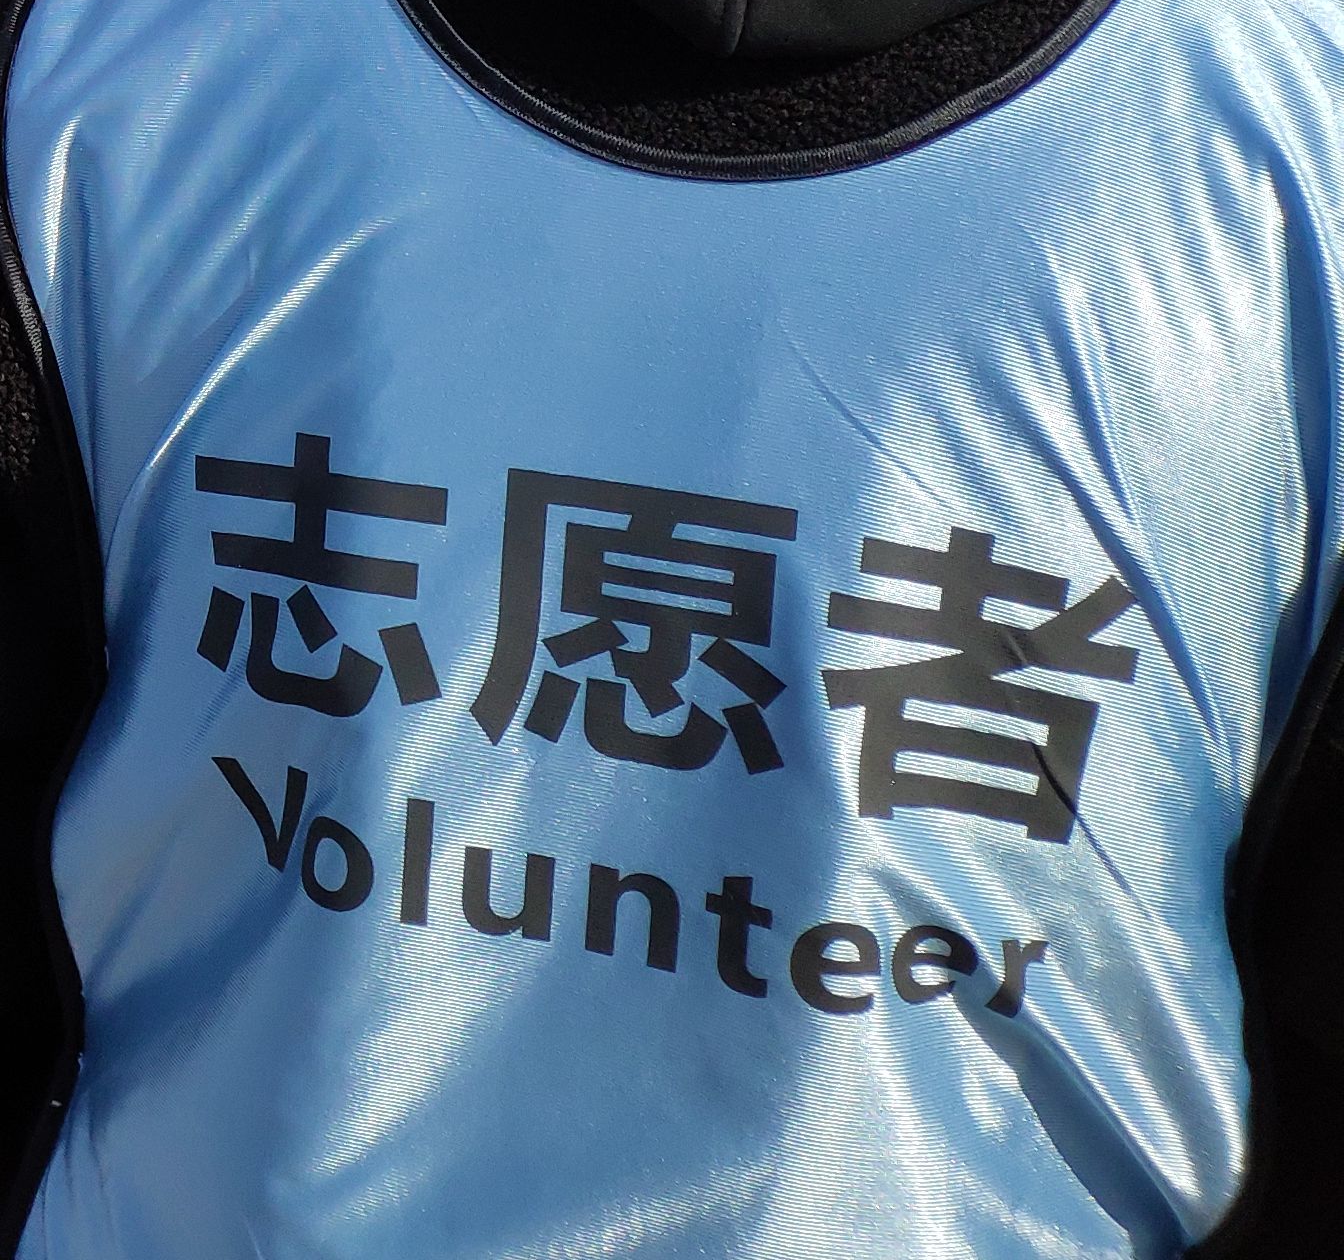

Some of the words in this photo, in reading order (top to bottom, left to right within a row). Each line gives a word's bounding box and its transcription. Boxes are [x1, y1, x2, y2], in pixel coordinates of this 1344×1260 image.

[194, 431, 1142, 847] 志愿者
[211, 755, 1050, 1019] Volunteer
